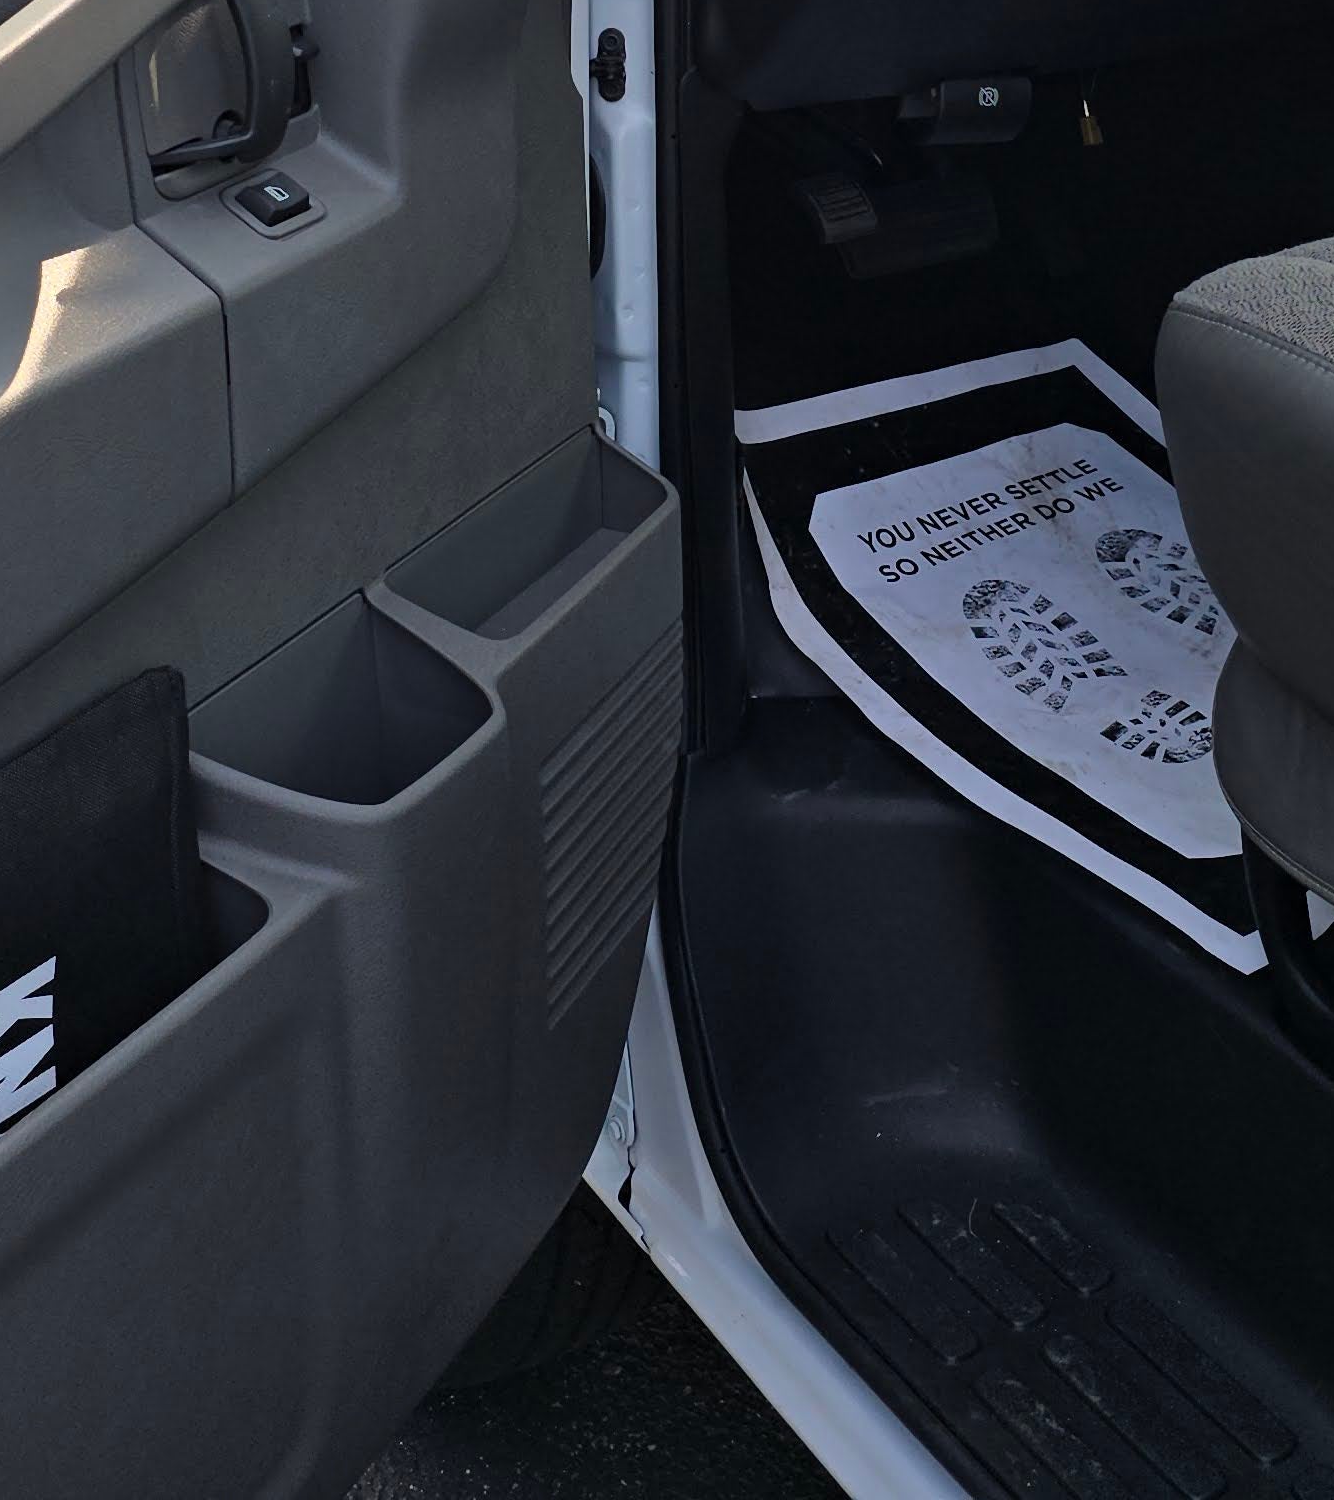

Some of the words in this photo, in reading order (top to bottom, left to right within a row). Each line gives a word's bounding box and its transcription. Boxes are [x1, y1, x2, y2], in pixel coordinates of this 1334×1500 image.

[857, 521, 915, 553] YOU
[916, 492, 1008, 534] NEVER
[1004, 459, 1098, 500] SETTLE
[878, 558, 919, 583] SO
[920, 512, 1036, 566] NEITHER
[1033, 498, 1075, 520] DO
[1074, 477, 1124, 501] WE
